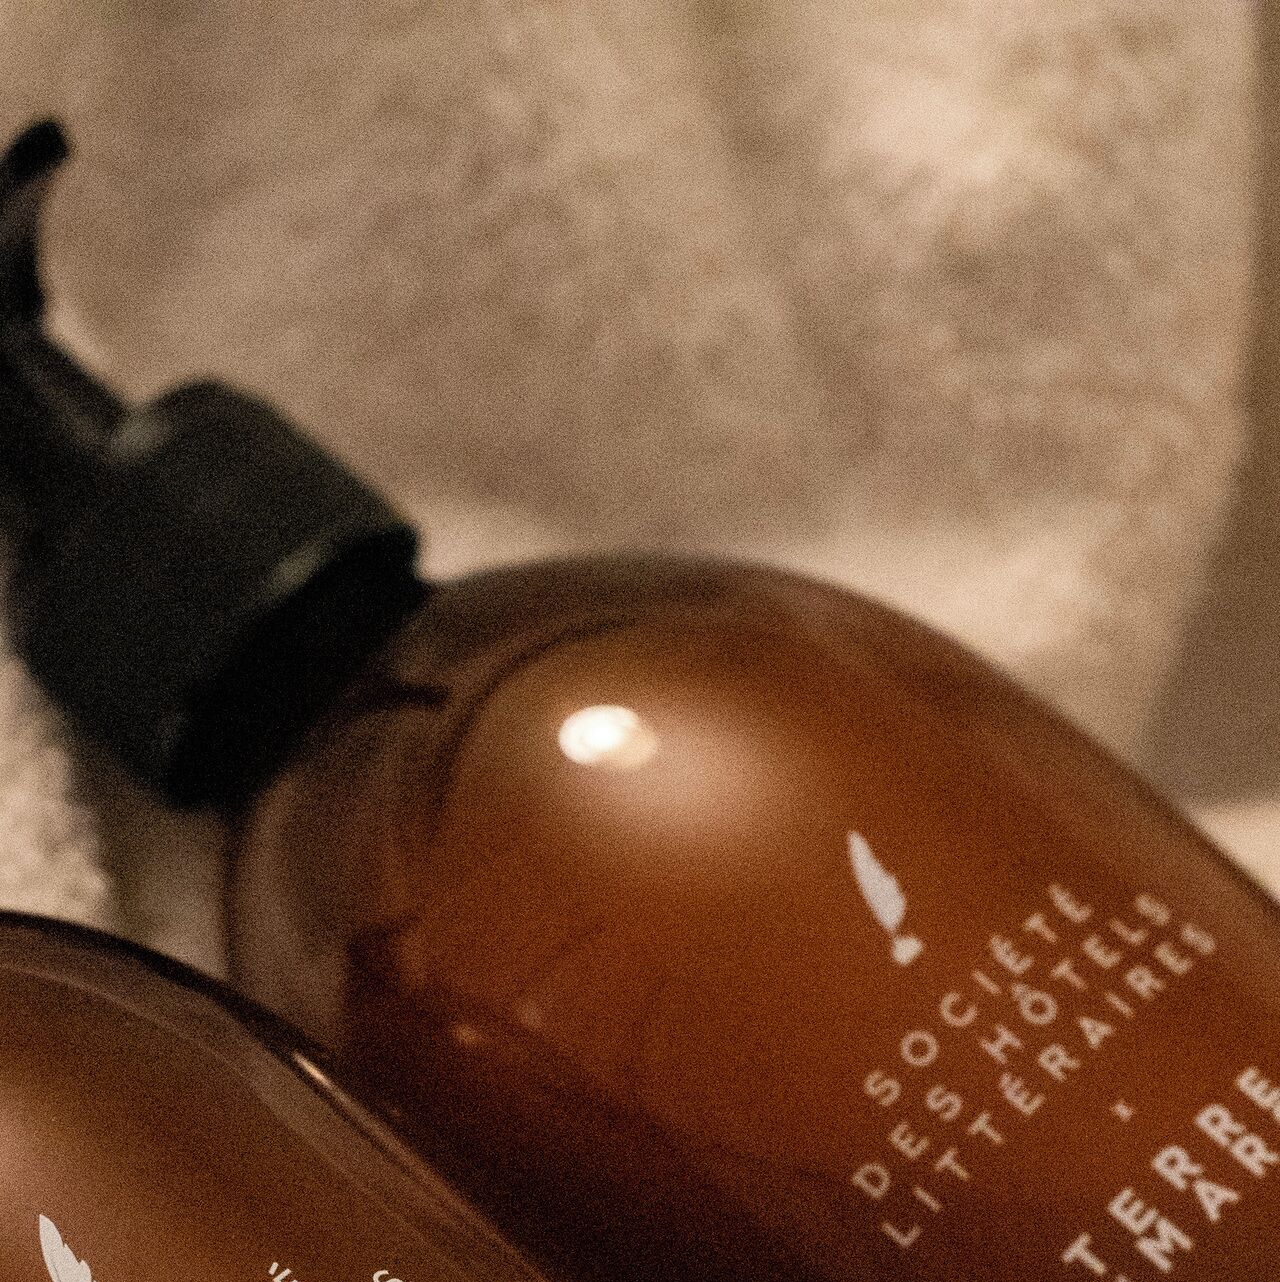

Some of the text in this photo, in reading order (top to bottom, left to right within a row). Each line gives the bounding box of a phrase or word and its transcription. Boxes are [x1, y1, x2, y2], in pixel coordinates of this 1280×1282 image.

[851, 894, 1172, 1198] DES HÔTELS
[863, 883, 1092, 1106] SOCIÉTÉ
[882, 923, 1216, 1248] LITTÉRAIRES
[1061, 1066, 1276, 1274] TERRE
